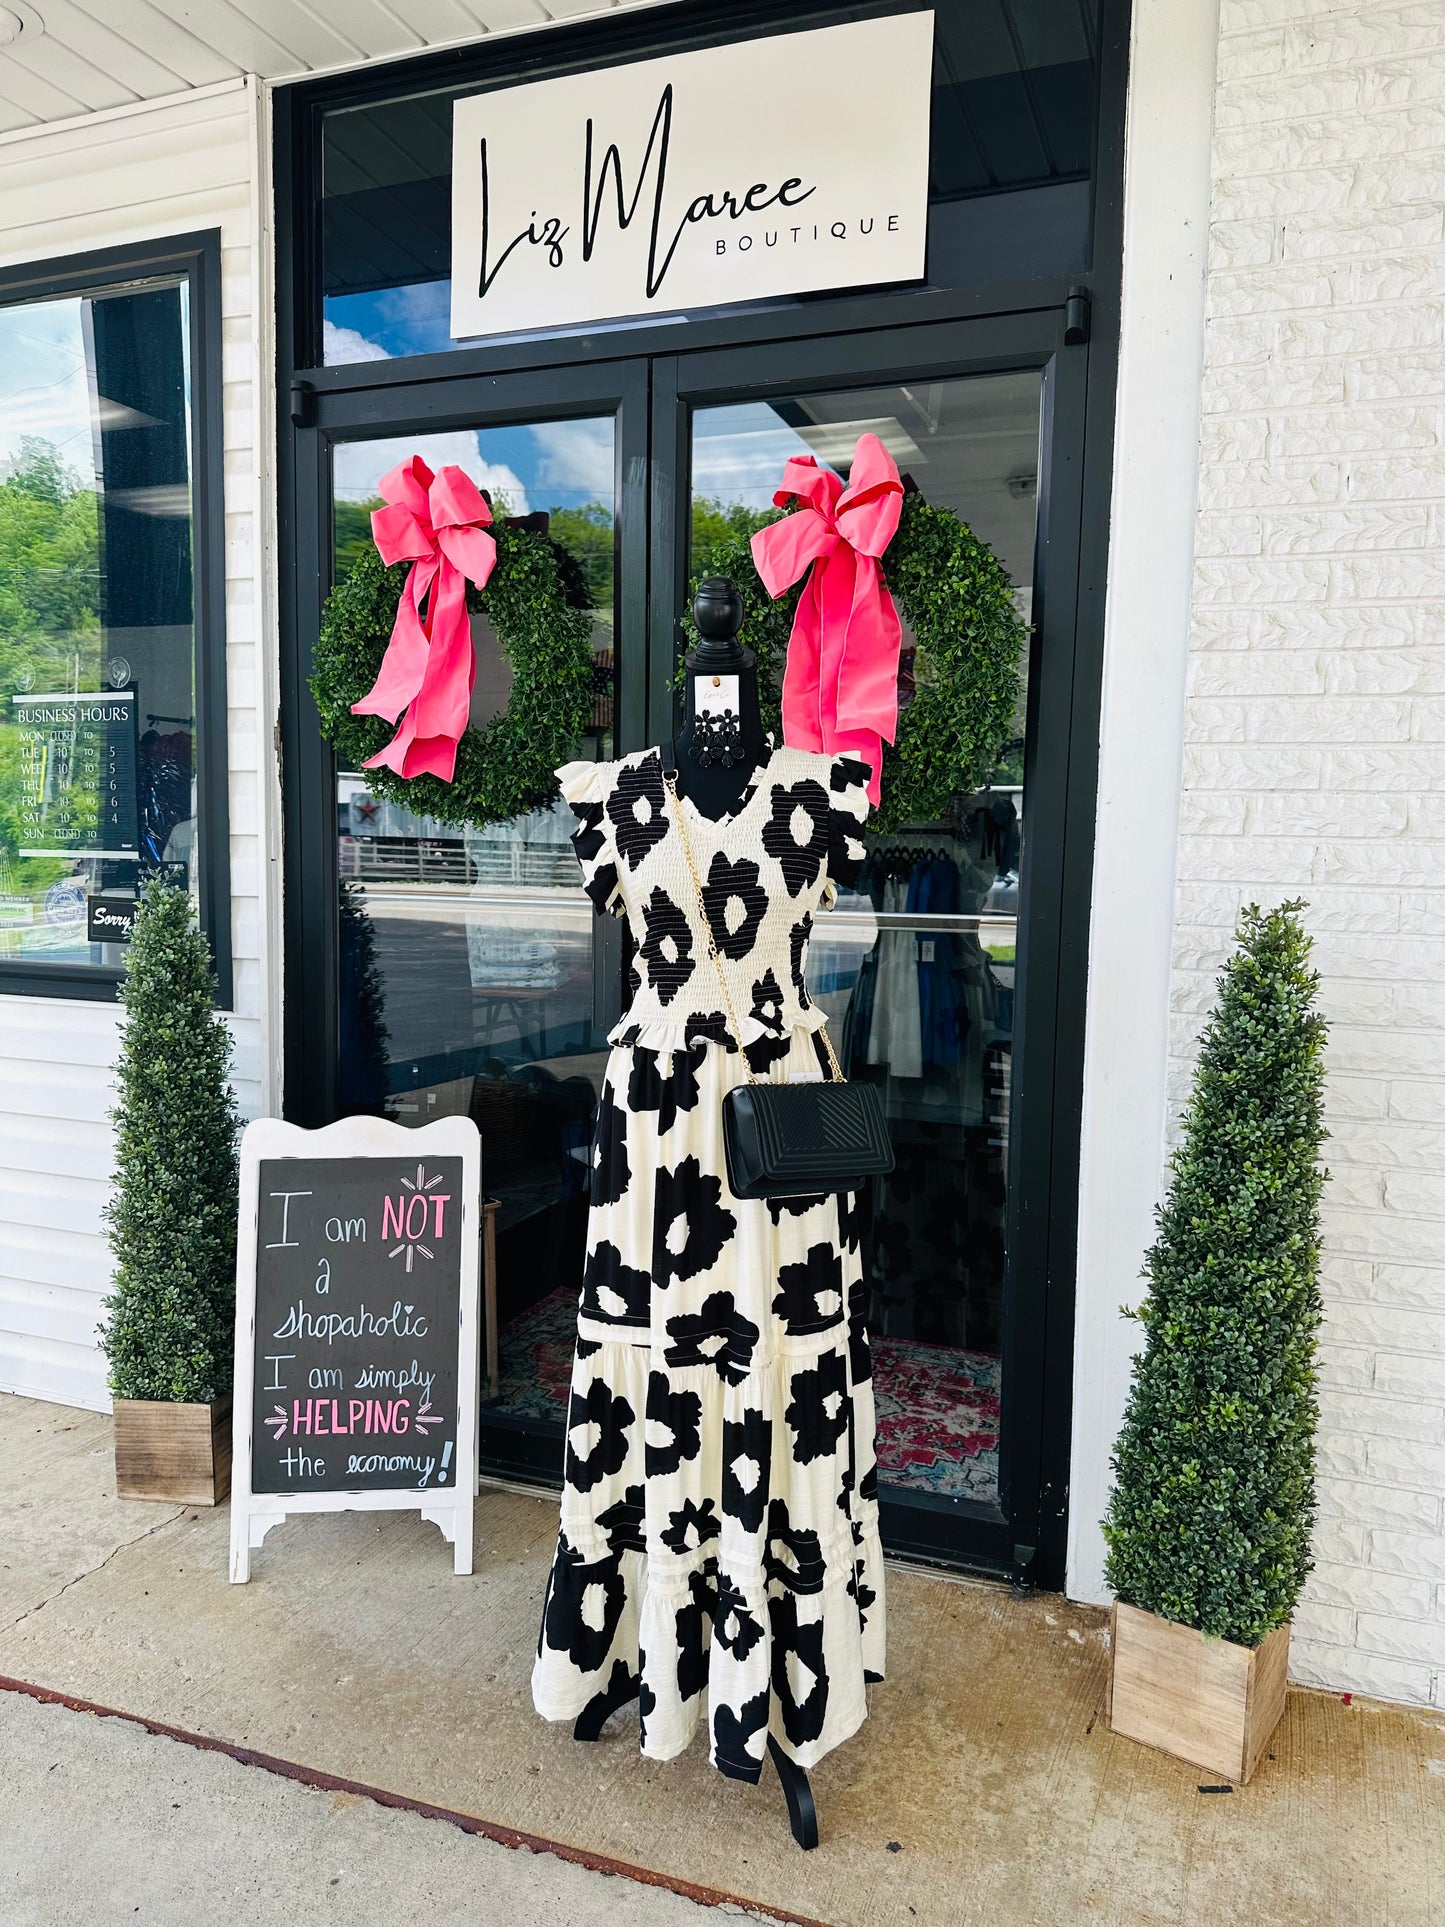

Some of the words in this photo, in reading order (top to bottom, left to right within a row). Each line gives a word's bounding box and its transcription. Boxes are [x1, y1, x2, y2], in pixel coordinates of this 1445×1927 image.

[479, 137, 570, 298] Liz
[582, 83, 817, 298] Maree
[716, 214, 900, 256] BOUTIQUE
[18, 708, 76, 723] BUSINESS
[81, 706, 129, 722] HOURS
[20, 731, 45, 742] MON
[83, 731, 93, 740] TO
[20, 747, 40, 759] TUE
[57, 747, 68, 758] 10
[84, 748, 94, 756] TO
[109, 746, 116, 758] 5
[20, 763, 44, 775] WED
[58, 763, 68, 774] 10
[84, 764, 95, 773] TO
[109, 762, 116, 774] 5
[22, 780, 42, 791] THU
[59, 779, 69, 791] 10
[85, 781, 95, 789] TO
[110, 779, 117, 791] 6
[21, 795, 37, 807] FRI
[59, 796, 69, 807] 10
[86, 797, 96, 806] TO
[111, 796, 118, 807] 6
[22, 812, 40, 823] SAT
[60, 813, 70, 823] 10
[87, 814, 97, 822] TO
[111, 813, 118, 824] 4
[23, 828, 45, 839] SUN
[87, 830, 97, 839] TO
[93, 907, 131, 935] Sorry
[265, 1191, 313, 1249] I
[325, 1217, 367, 1243] am
[381, 1194, 451, 1240] NOT
[315, 1257, 331, 1294] a
[273, 1299, 428, 1345] shopaholic
[264, 1354, 296, 1390] I
[308, 1367, 344, 1390] am
[354, 1359, 436, 1407] simply
[292, 1399, 411, 1435] HELPING
[279, 1447, 326, 1477] the
